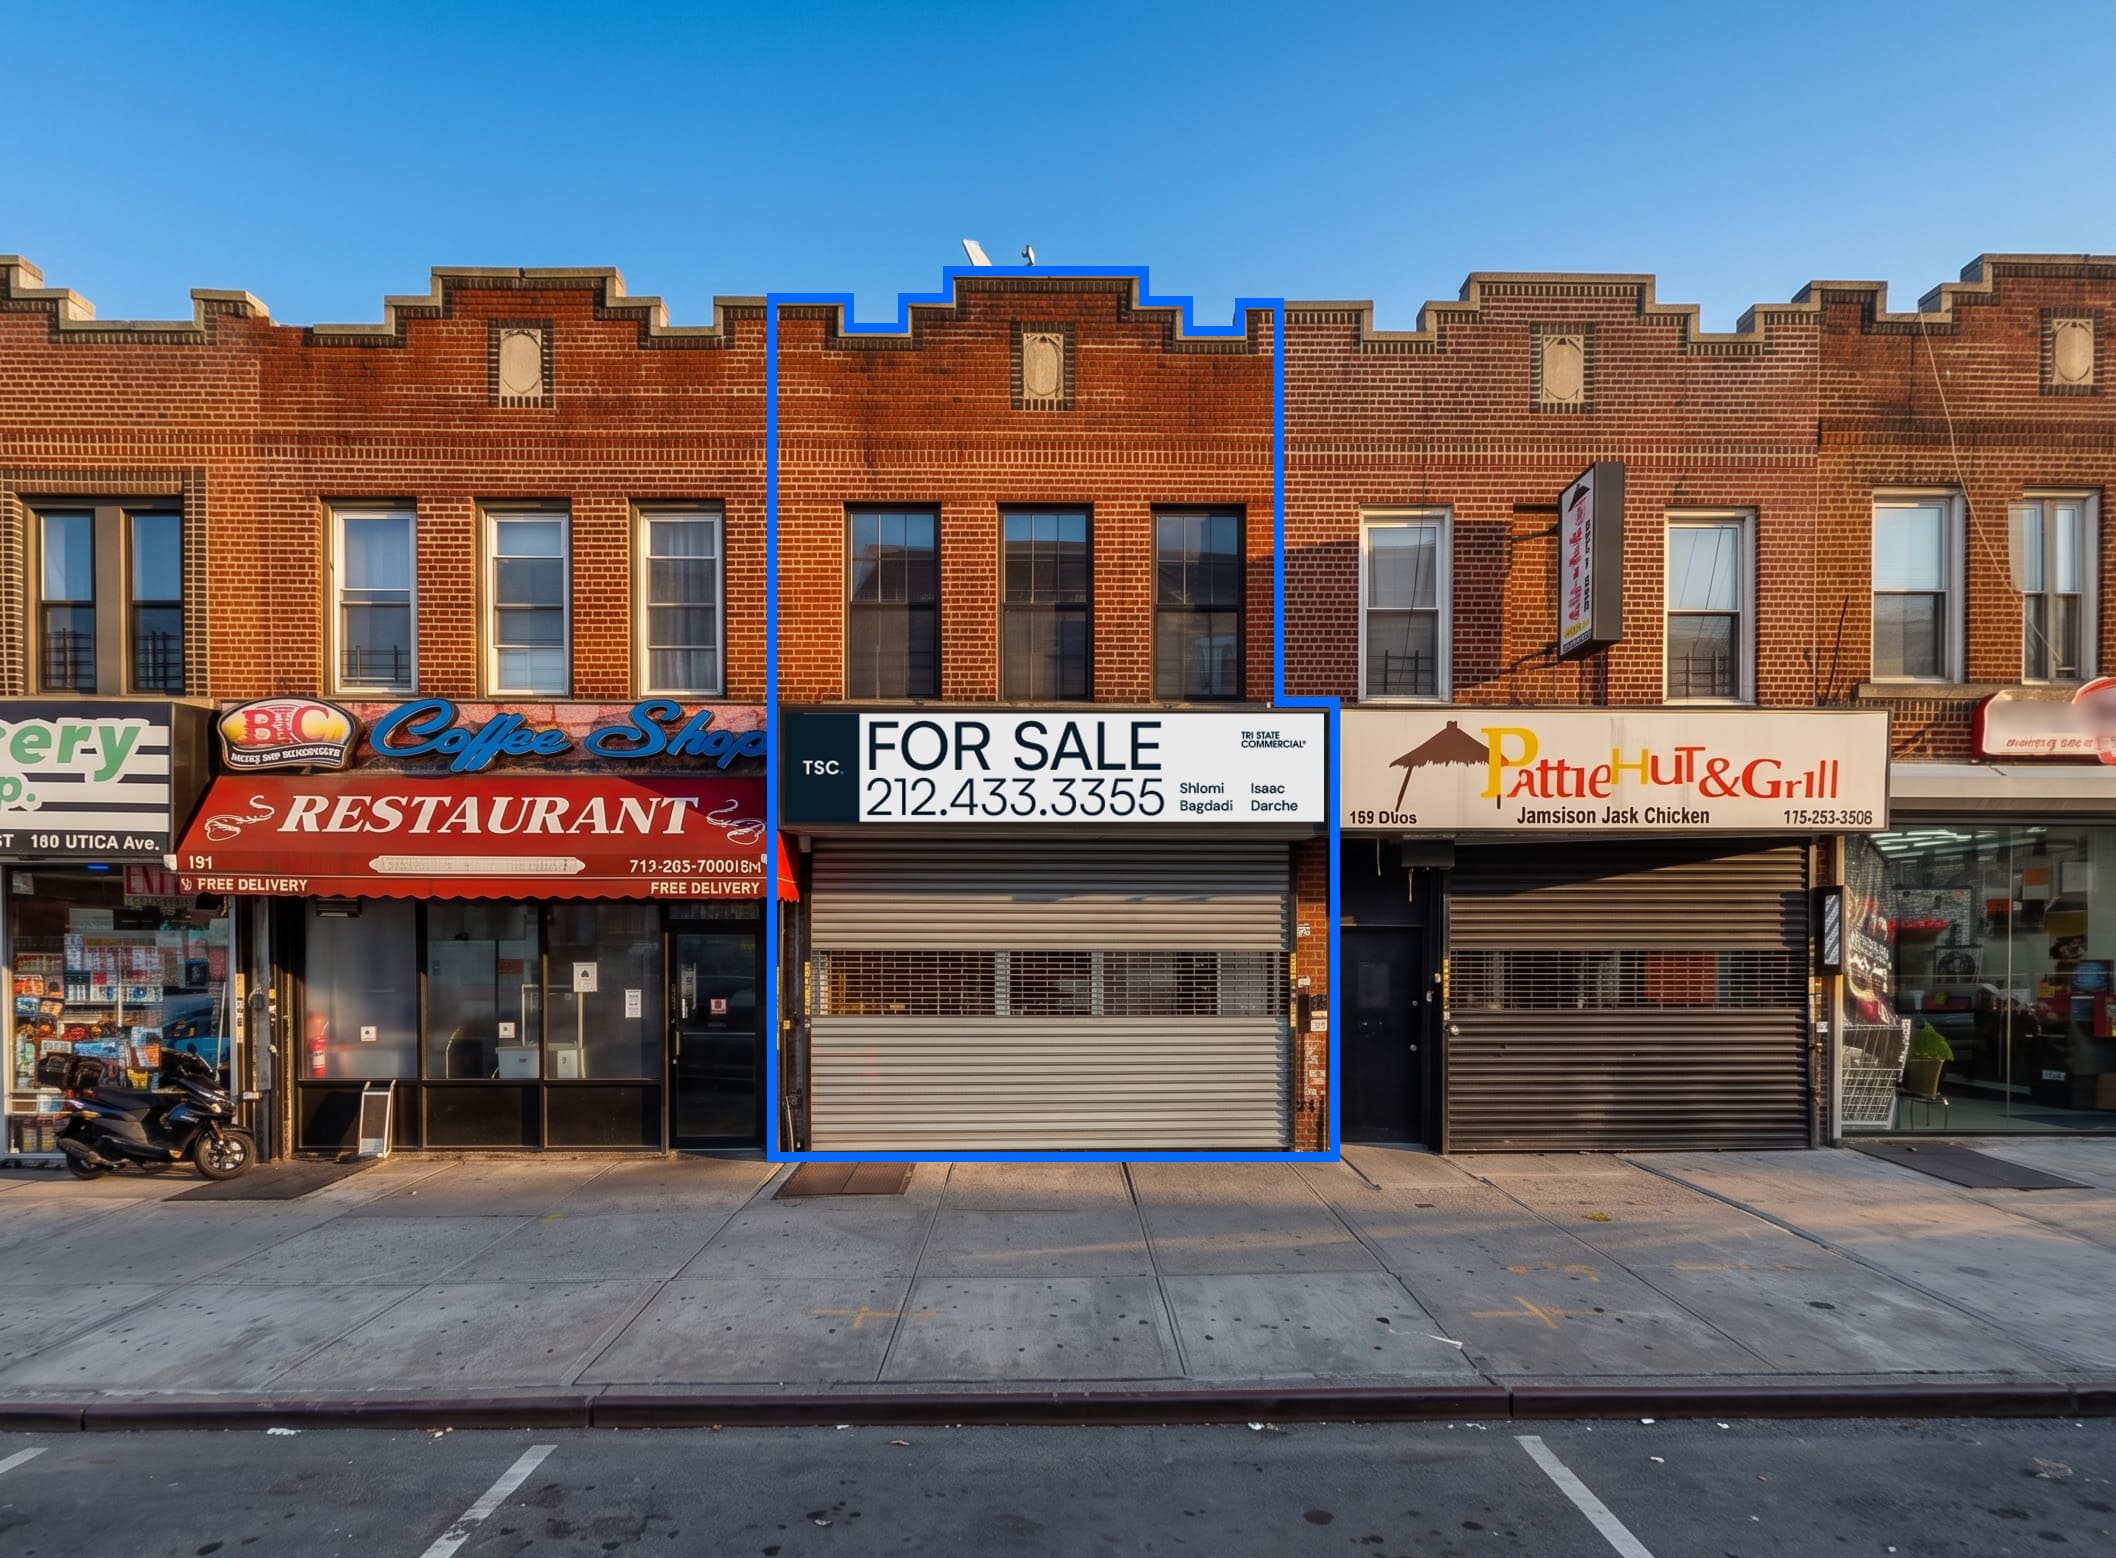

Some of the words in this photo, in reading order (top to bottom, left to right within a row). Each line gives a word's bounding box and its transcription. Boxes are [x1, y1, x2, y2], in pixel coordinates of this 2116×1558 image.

[370, 698, 573, 772] Coffee
[1241, 731, 1254, 739] TRI
[1256, 731, 1280, 739] STATE
[868, 721, 991, 771] FOR
[1014, 720, 1162, 771] SALE
[0, 725, 142, 782] ery
[1179, 782, 1225, 794] Shlomi
[1251, 782, 1286, 794] Isaac
[867, 778, 1165, 816] 212.433.3355
[1180, 799, 1233, 814] Bagdadi
[1251, 799, 1299, 811] Darche
[277, 795, 698, 834] RESTAURANT
[1602, 806, 1639, 824] Jask
[1644, 806, 1710, 824] Chicken
[66, 834, 118, 849] UTICA
[123, 836, 160, 850] Ave.
[189, 855, 213, 870] 191
[197, 878, 234, 891] FREE
[238, 878, 308, 892] DELIVERY
[651, 881, 687, 895] FREE
[691, 881, 760, 895] DELIVERY
